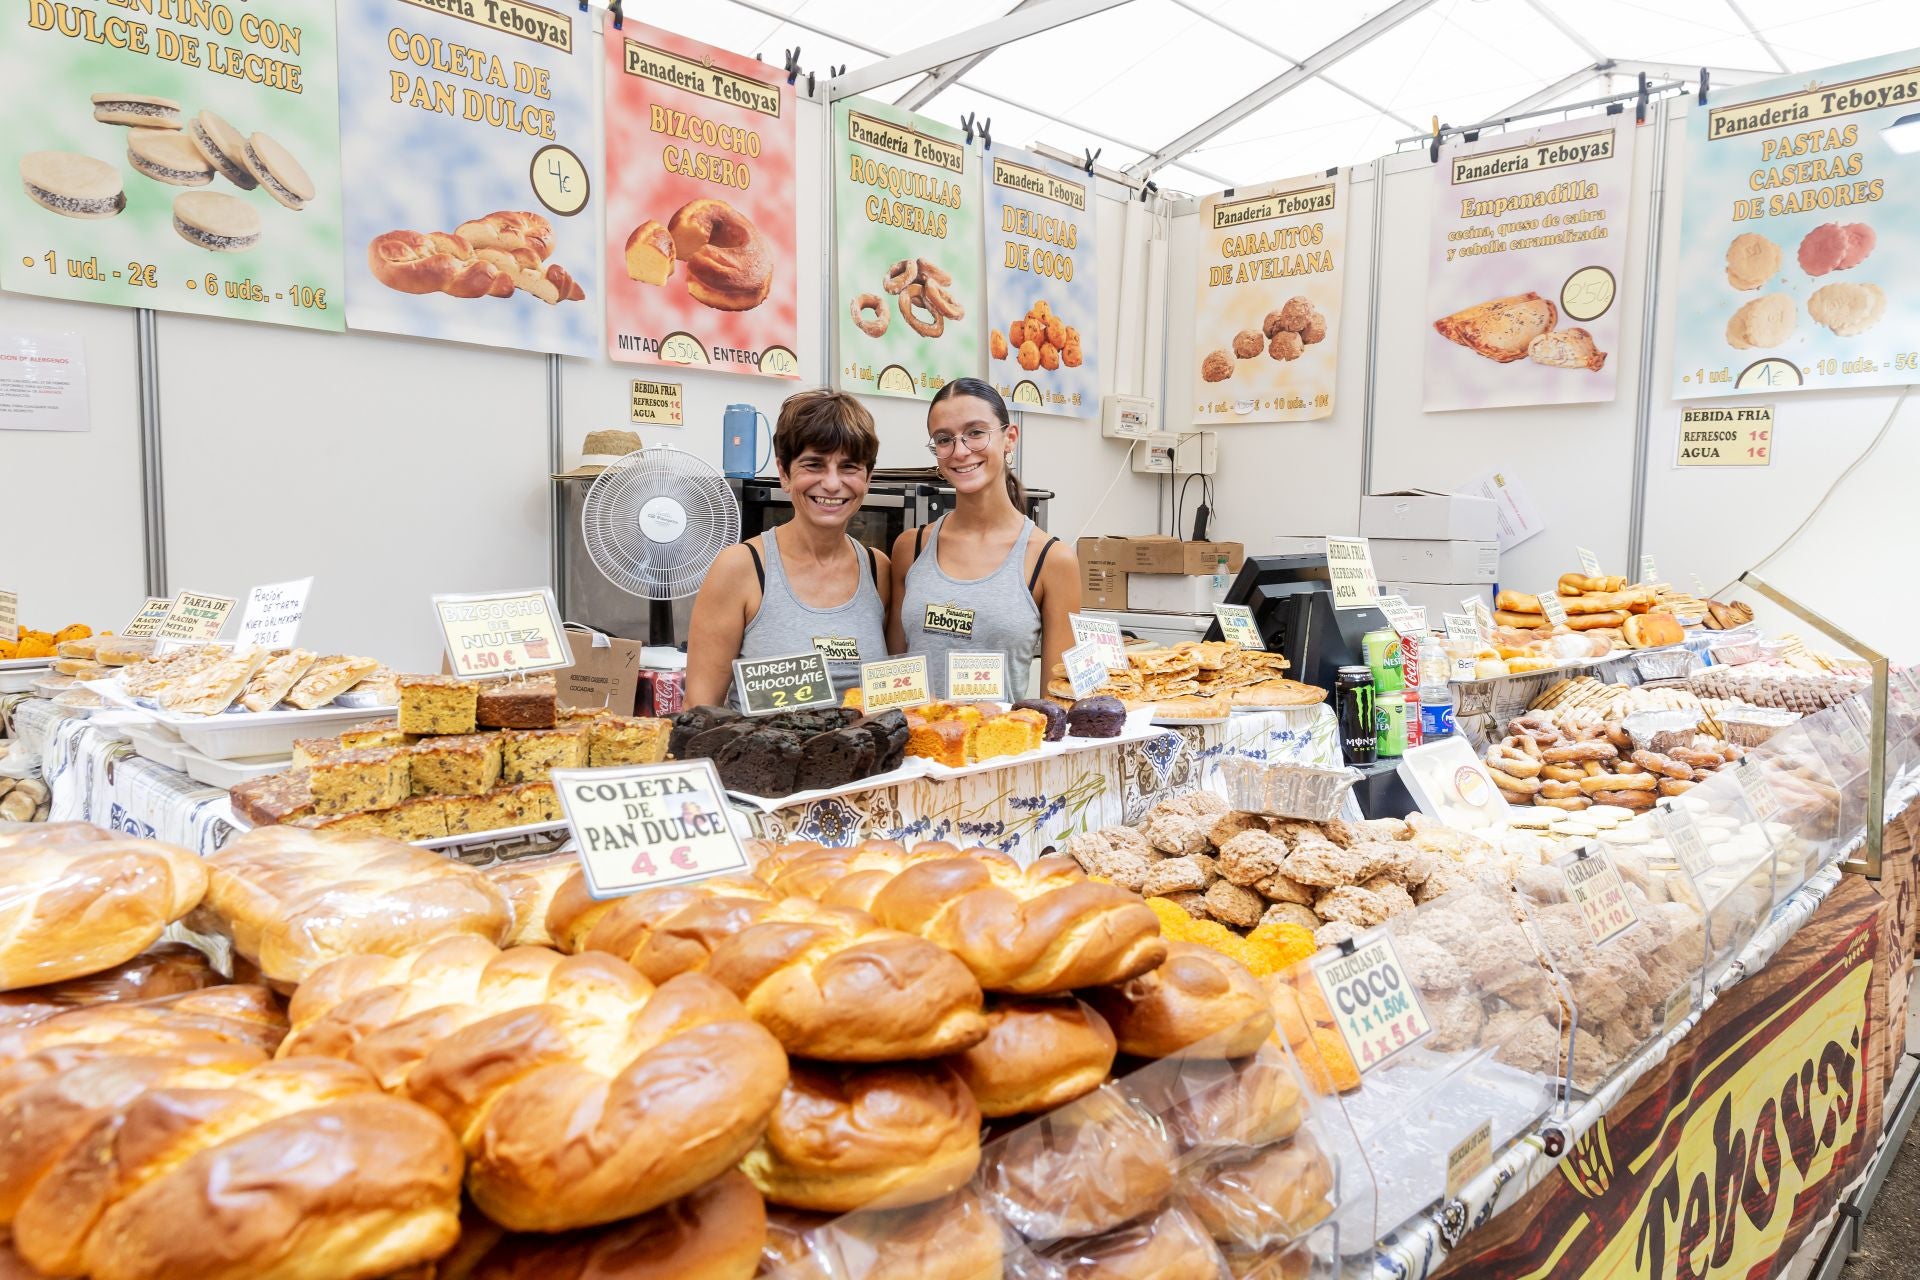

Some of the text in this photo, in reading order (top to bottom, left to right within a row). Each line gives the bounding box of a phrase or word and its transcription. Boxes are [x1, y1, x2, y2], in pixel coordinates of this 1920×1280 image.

[240, 13, 301, 55] CON
[484, 0, 568, 47] Teboyas
[28, 0, 303, 94] DULCE DE LECHE
[388, 28, 551, 100] COLETA DE
[629, 50, 777, 112] Panaderia Teboyas
[390, 71, 556, 141] PAN DULCE
[1714, 81, 1919, 135] Panaderia Teboyas
[650, 104, 761, 159] BIZCOCHO
[1762, 125, 1858, 161] PASTAS
[852, 121, 961, 170] Panaderia Teboyas
[663, 145, 751, 190] CASERO
[1456, 141, 1609, 181] Panaderia Teboyas
[1749, 153, 1863, 191] CASERAS
[850, 154, 961, 209] ROSQUILLAS
[996, 166, 1083, 207] Panaderia Teboyas
[1217, 193, 1331, 225] Panaderia Teboyas
[1461, 180, 1599, 218] Empanadilla
[1733, 179, 1884, 221] DE SABORES
[866, 195, 947, 239] CASERAS
[1002, 205, 1077, 249] DELICIAS
[1448, 209, 1606, 242] cecina, queso de cabra
[1222, 223, 1323, 258] CARAJITOS
[1447, 226, 1609, 261] y cebolla caramelizada
[44, 250, 57, 274] 1
[67, 256, 106, 281] ud.
[128, 262, 158, 288] 2€
[1005, 241, 1073, 282] DE COCO
[1209, 250, 1334, 287] DE AVELLANA
[205, 273, 218, 295] 6
[225, 279, 270, 302] uds.
[289, 285, 327, 309] 10€
[618, 334, 659, 353] MITAD
[714, 346, 759, 365] ENTERO
[1695, 368, 1732, 384] 1 ud.
[1817, 352, 1919, 375] 10 uds. 5€
[634, 382, 677, 396] BEBIDA FRIA
[633, 397, 681, 409] REFRESCOS 1€
[633, 409, 681, 420] AGUA 1€
[1684, 410, 1770, 422] BEBIDA FRIA
[1684, 431, 1768, 442] REFRESCOS 1€
[1681, 447, 1766, 458] AGUA 1€
[1330, 544, 1366, 560] BEBIDA FRIA
[1332, 568, 1363, 579] REFRESCOS
[183, 596, 228, 611] TARTA DE
[1336, 586, 1357, 598] AGUA
[182, 607, 219, 620] NUEZ
[444, 600, 545, 622] BIZCOCHO
[927, 611, 972, 632] Teboyas
[946, 608, 973, 618] Panaderia
[165, 622, 194, 633] MITAD
[461, 628, 544, 649] NUEZ
[488, 621, 510, 631] DE
[746, 657, 818, 678] SUPREM DE
[867, 662, 922, 680] BIZCOCHO
[952, 658, 1001, 669] BIZCOCHO
[957, 671, 990, 680] DE 2€
[746, 671, 824, 692] CHOCOLATE
[893, 677, 912, 688] 2€
[952, 683, 999, 695] NARANJA
[772, 685, 814, 706] 2 €
[868, 687, 925, 707] ZANAHORIA
[576, 777, 698, 803] COLETA
[624, 802, 654, 820] DE
[585, 811, 726, 851] PAN DULCE
[631, 846, 698, 876] 4 €
[1567, 855, 1607, 886] CARAJITOS
[1575, 887, 1587, 902] DE
[1584, 904, 1591, 919] 1
[1609, 909, 1624, 927] 10
[1326, 943, 1387, 986] DELICIAS DE
[1335, 962, 1400, 1015] COCO
[1350, 1018, 1360, 1037] 1
[1372, 990, 1410, 1027] 1.50€
[1362, 1040, 1374, 1063] 4
[1391, 1022, 1405, 1042] 5
